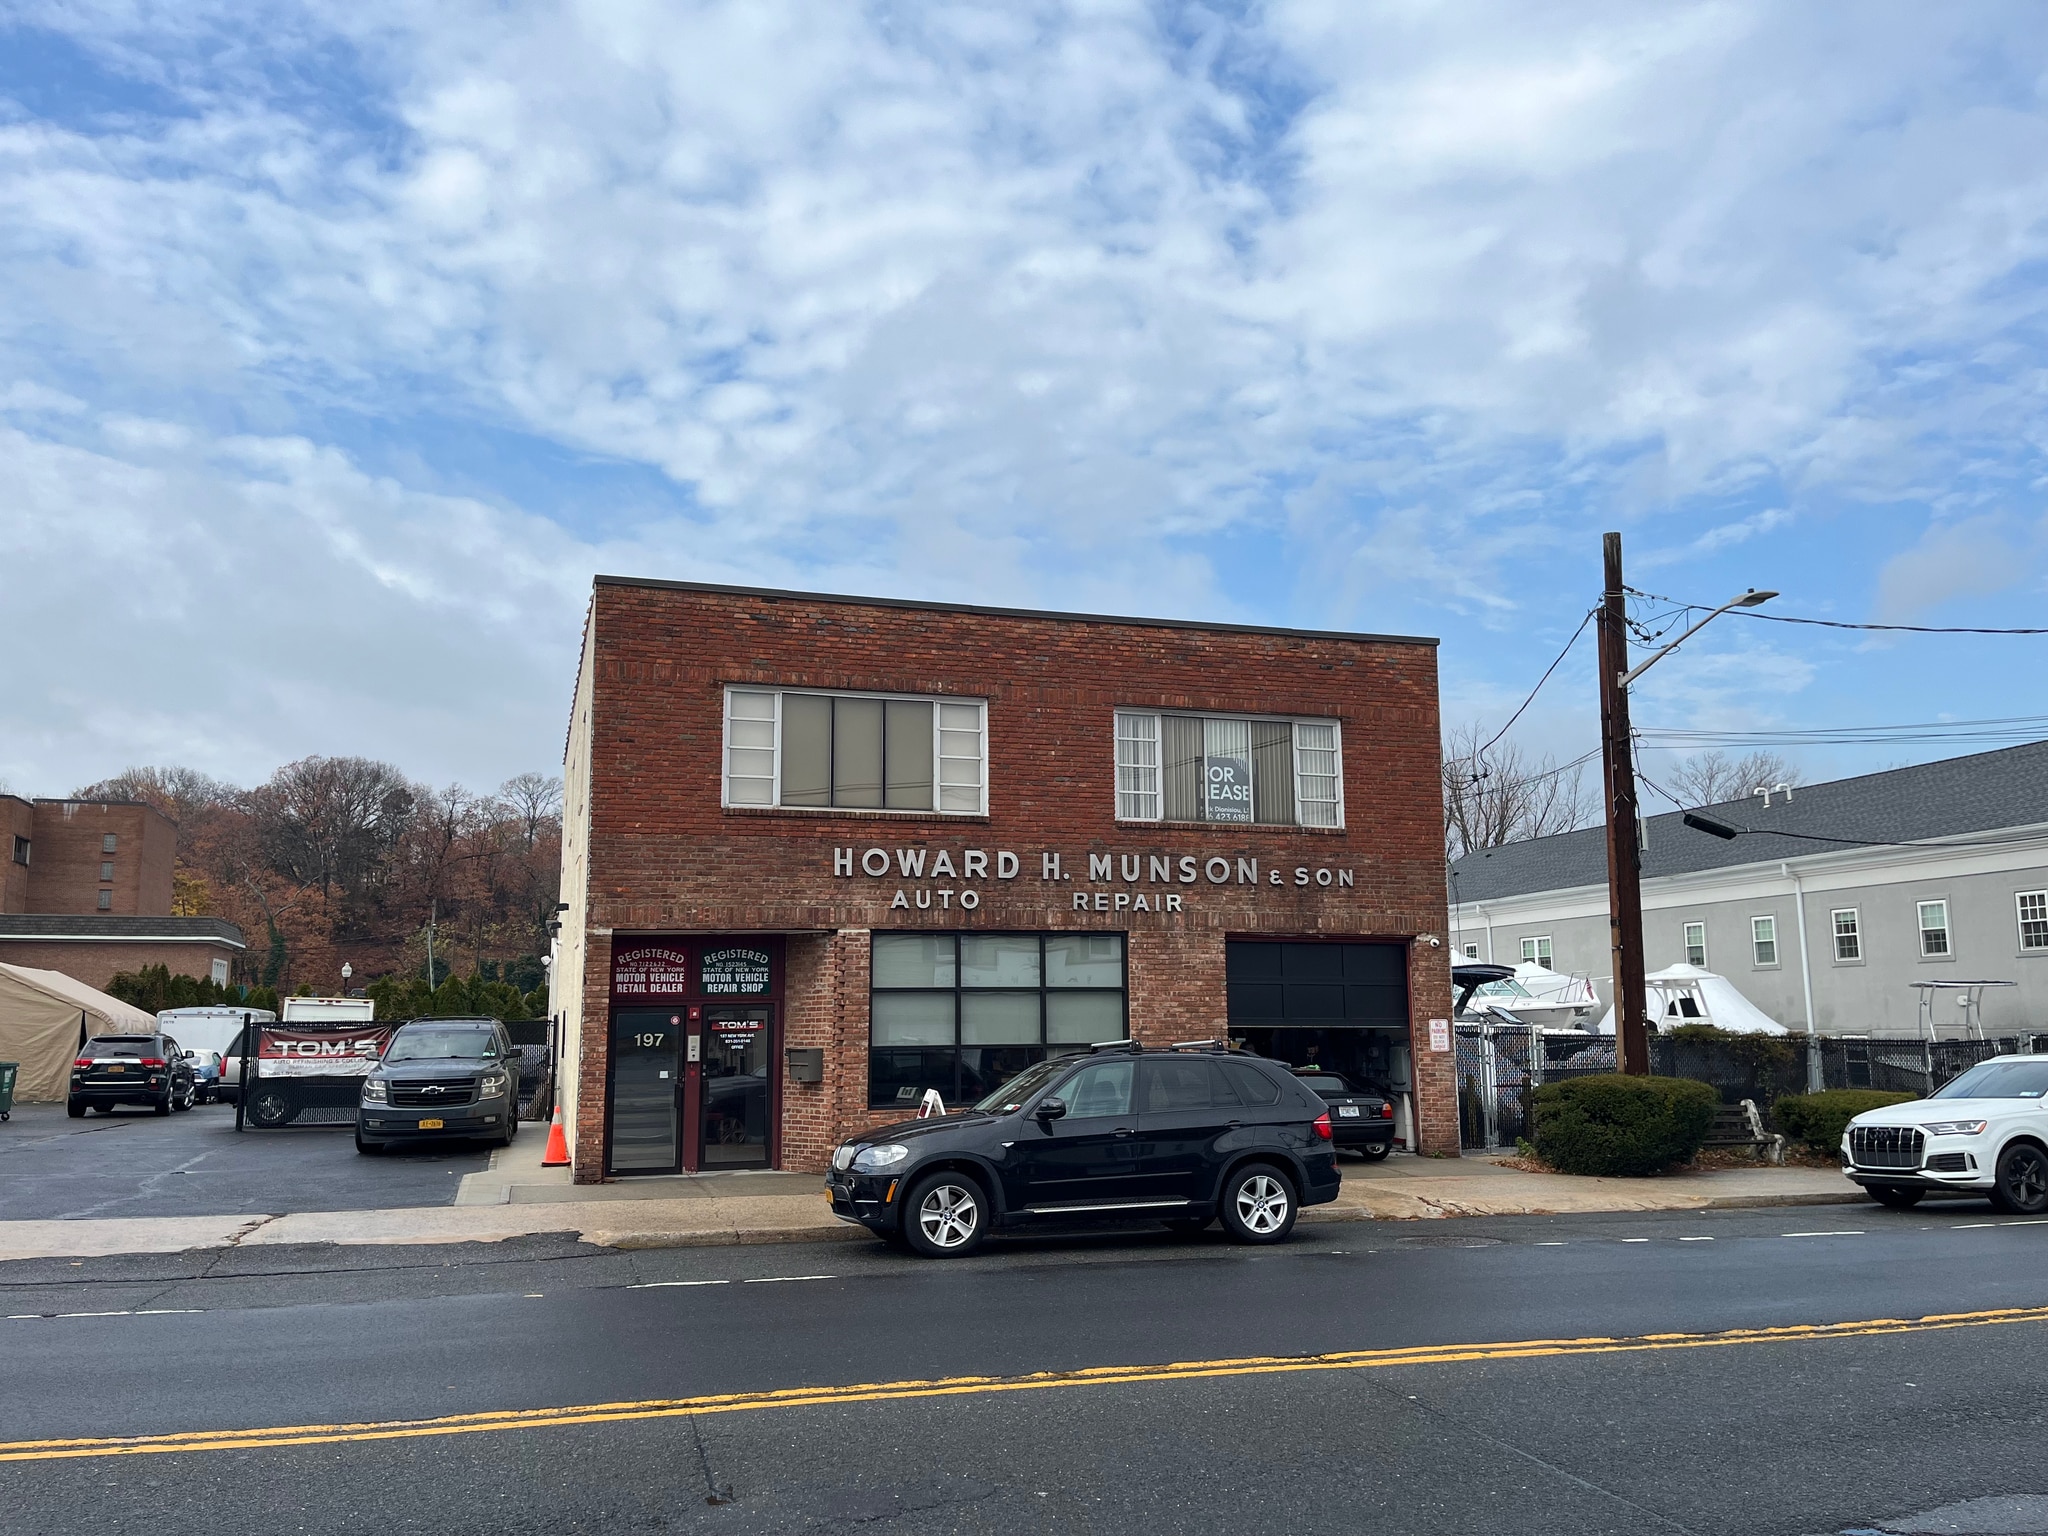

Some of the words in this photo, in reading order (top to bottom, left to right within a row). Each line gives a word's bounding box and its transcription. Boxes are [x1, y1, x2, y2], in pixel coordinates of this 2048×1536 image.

[1200, 813, 1249, 821] 6.423.6188
[833, 847, 1020, 880] HOWARD
[1042, 851, 1070, 880] H.
[1089, 853, 1258, 885] MUNSON
[1269, 869, 1284, 885] &
[1294, 867, 1355, 888] SON
[890, 889, 980, 910] AUTO
[1072, 892, 1183, 912] REPAIR
[617, 948, 685, 964] REGISTERED
[704, 949, 769, 965] REGISTERED
[615, 973, 646, 982] MOTOR
[649, 973, 685, 982] VEHICLE
[702, 973, 732, 982] MOTOR
[735, 973, 769, 982] VEHICLE
[616, 984, 647, 993] RETAIL
[650, 984, 683, 993] DEALER
[707, 984, 738, 993] REPAIR
[741, 983, 764, 992] SHOP
[718, 1020, 759, 1029] TOM'S
[634, 1033, 664, 1047] 197
[274, 1038, 377, 1056] TOM'S
